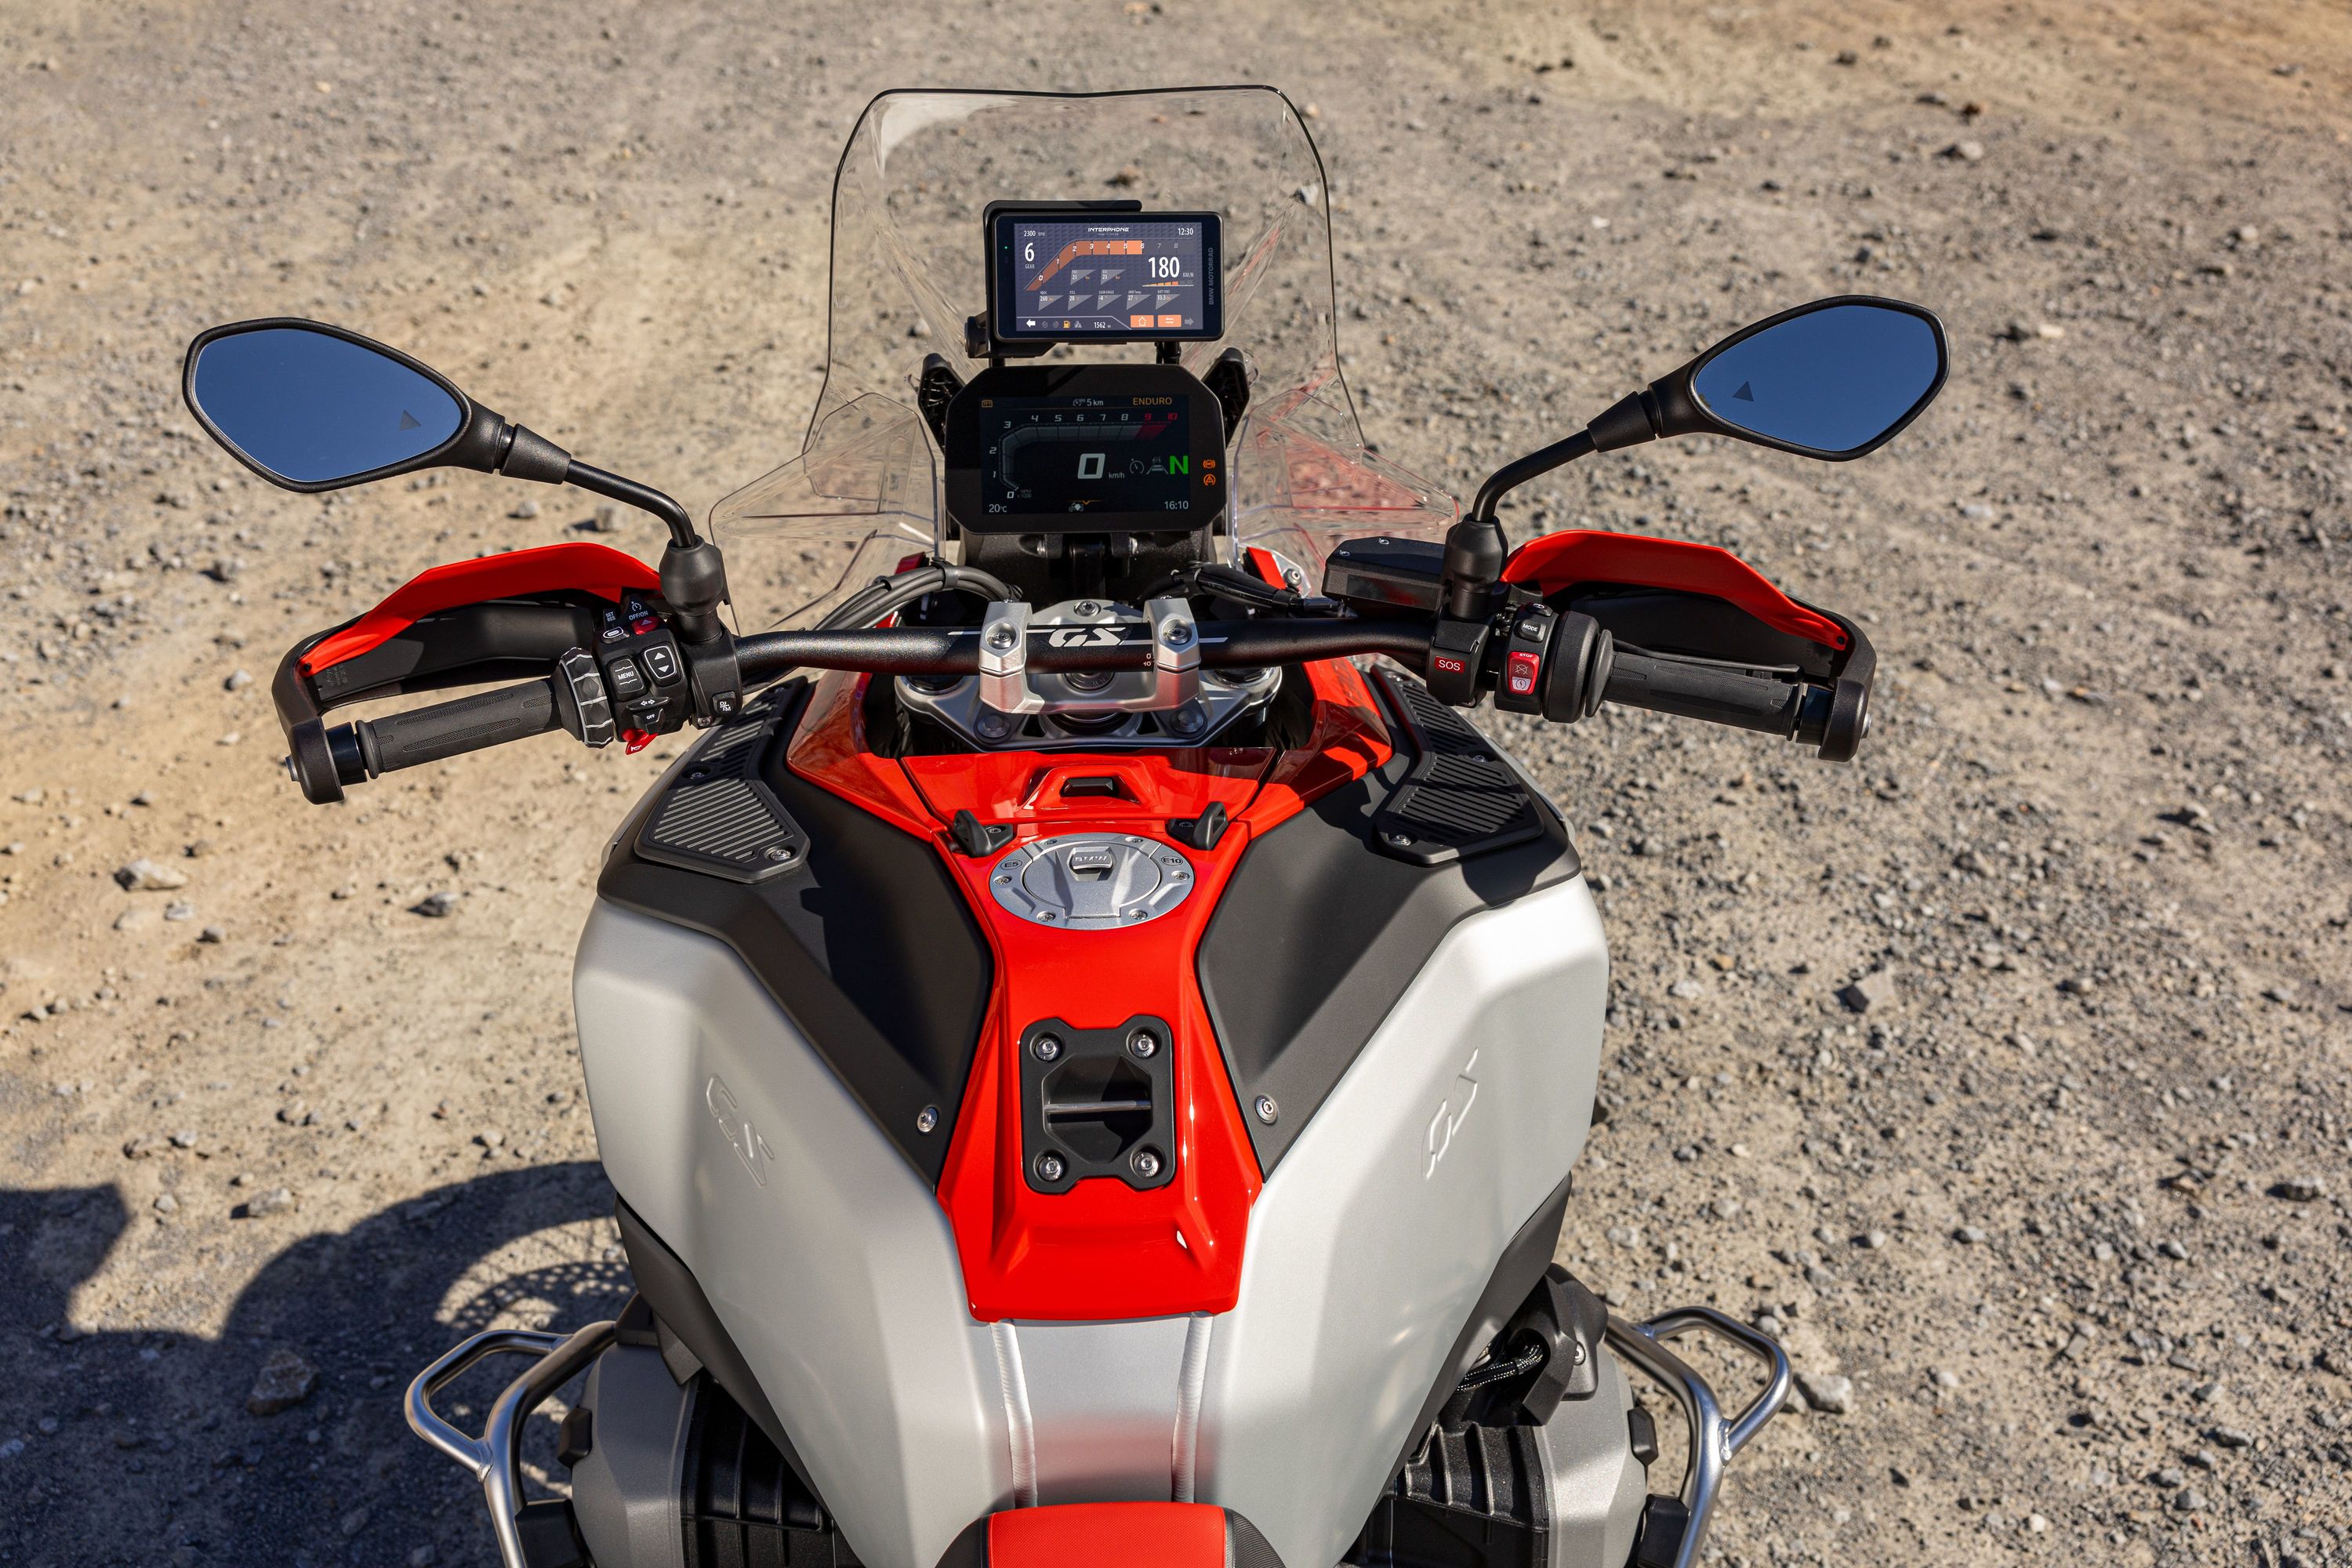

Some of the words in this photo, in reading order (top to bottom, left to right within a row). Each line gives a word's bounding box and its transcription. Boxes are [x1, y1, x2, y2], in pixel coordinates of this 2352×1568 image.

[1025, 242, 1035, 262] 6
[1148, 256, 1180, 278] 180
[1133, 397, 1173, 405] ENDURO
[1167, 412, 1178, 421] 10
[1077, 453, 1105, 479] 0
[1169, 456, 1189, 474] N
[1164, 500, 1189, 510] 16:10
[629, 611, 649, 620] OFF/ON
[1523, 623, 1538, 632] MODE
[1048, 627, 1127, 648] GS
[1439, 659, 1461, 671] SOS
[618, 670, 634, 681] MENU
